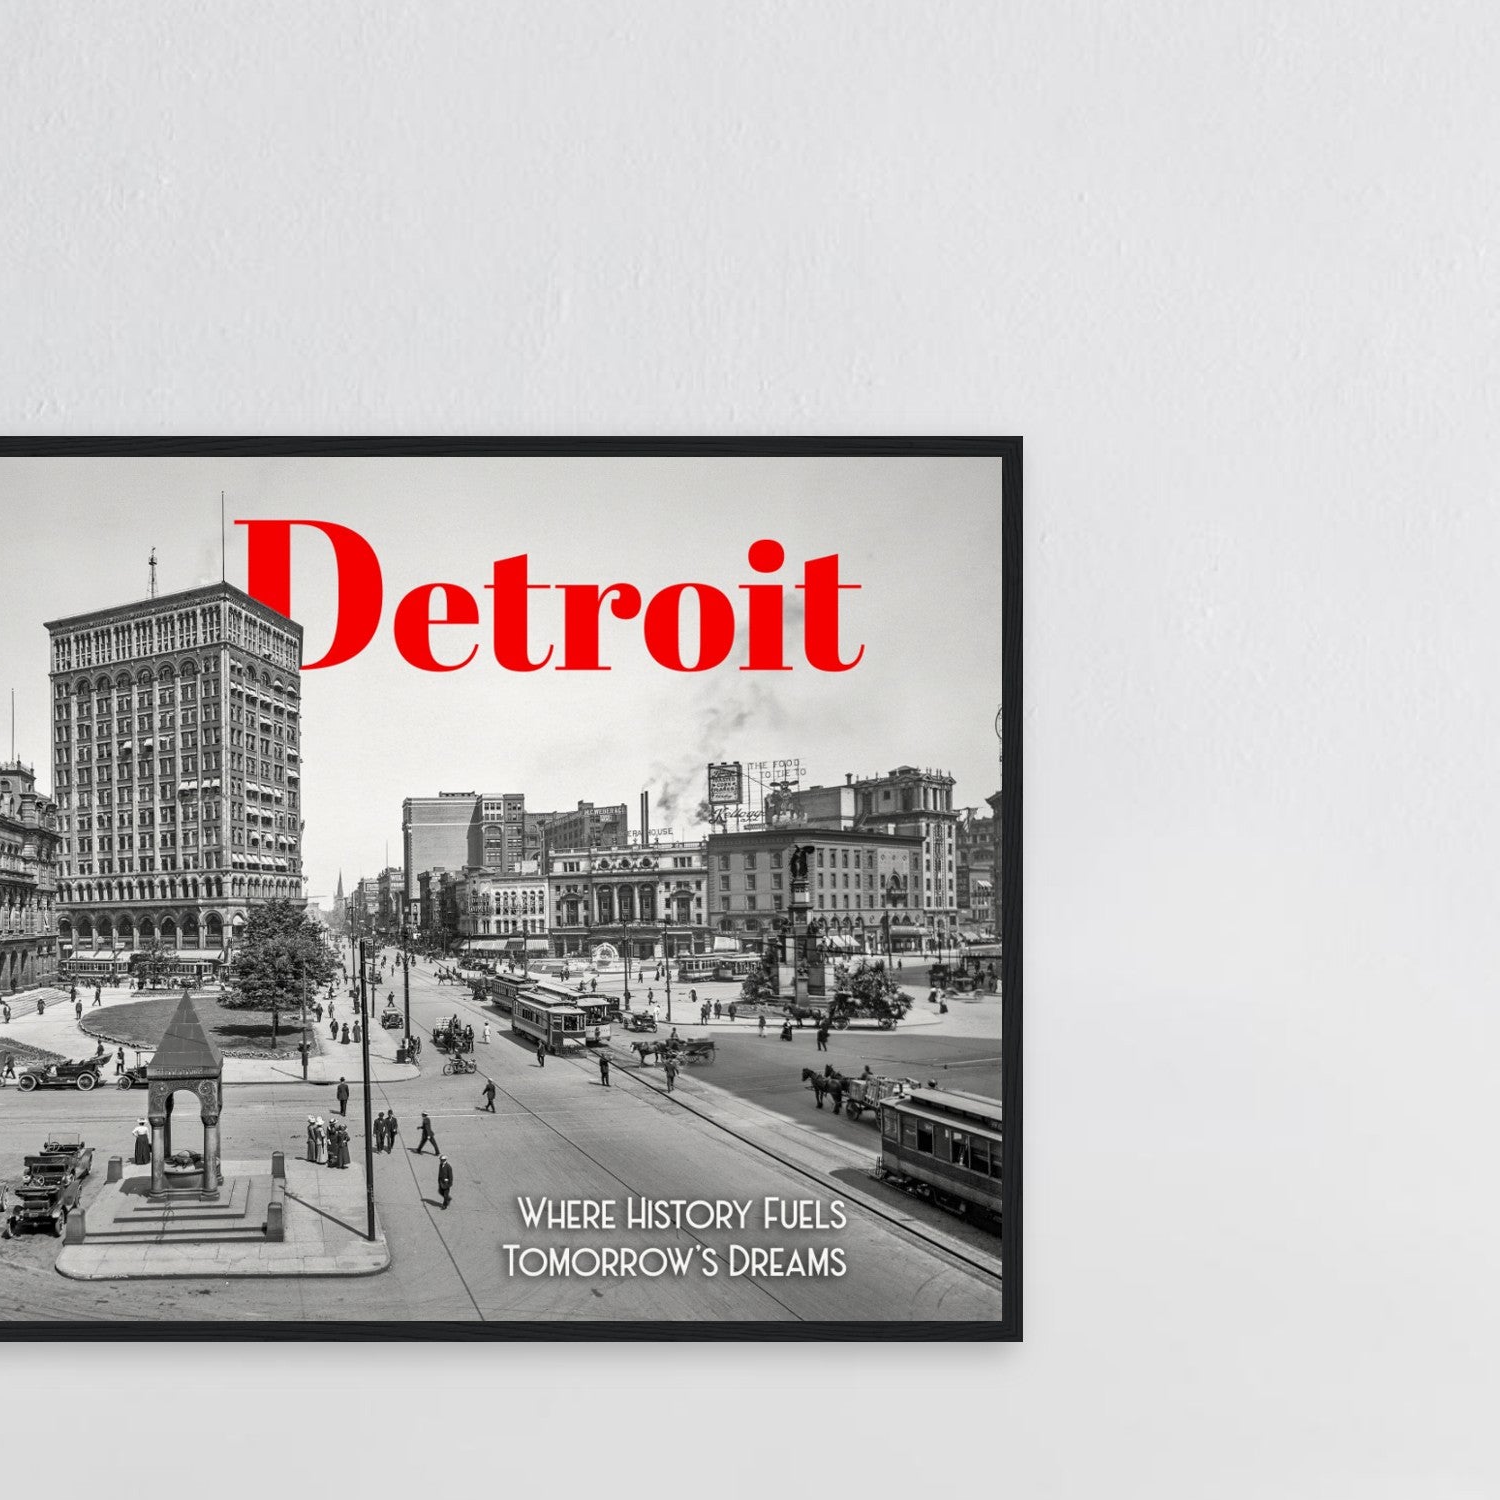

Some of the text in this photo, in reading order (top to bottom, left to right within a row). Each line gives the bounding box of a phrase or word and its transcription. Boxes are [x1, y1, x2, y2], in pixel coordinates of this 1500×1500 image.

[234, 519, 865, 673] Detroit
[749, 759, 800, 770] THE FOOD
